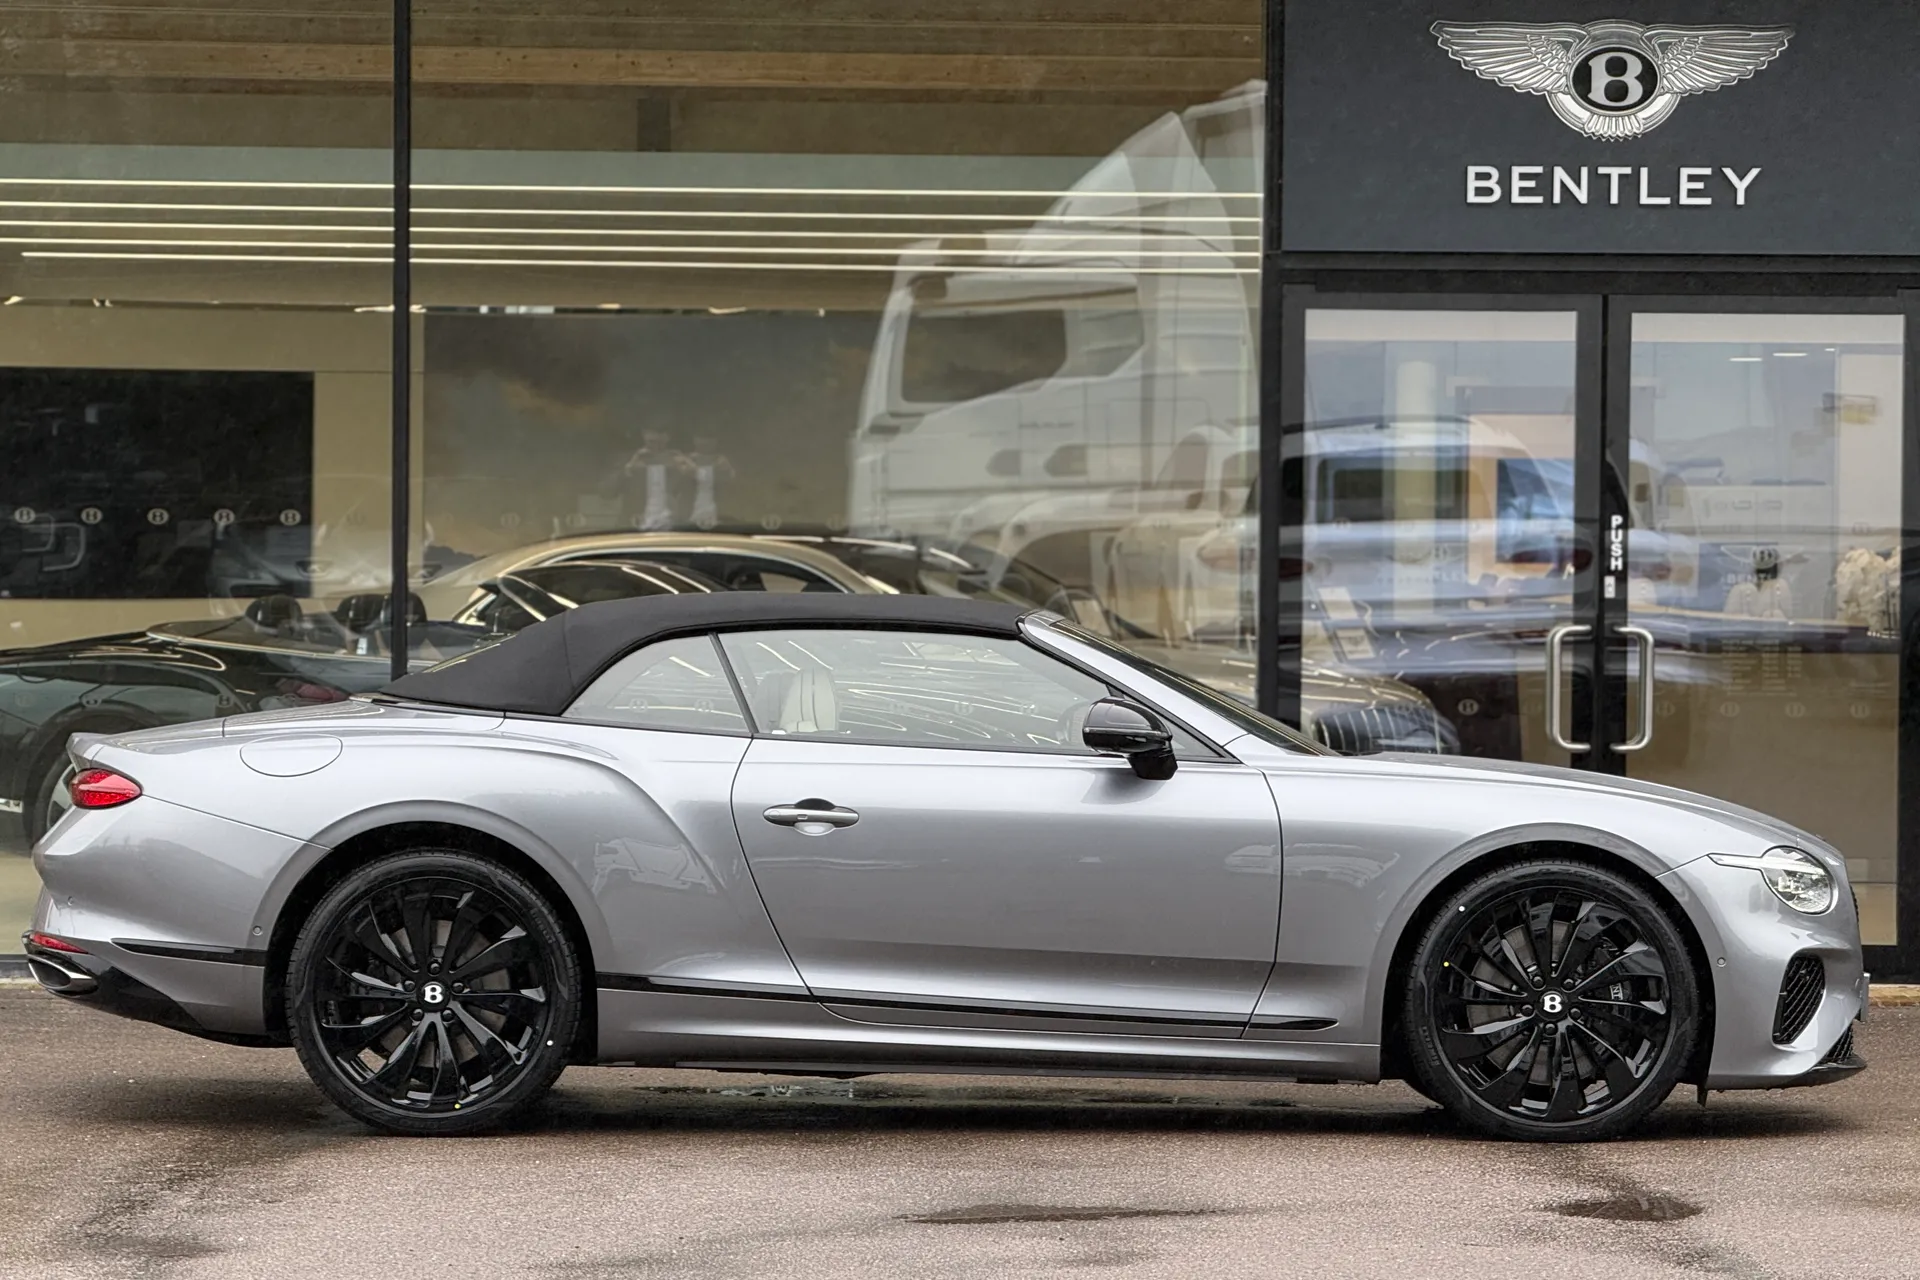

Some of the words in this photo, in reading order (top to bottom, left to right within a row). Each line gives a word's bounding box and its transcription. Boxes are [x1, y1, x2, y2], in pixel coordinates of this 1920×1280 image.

[1587, 51, 1644, 107] B
[1466, 165, 1762, 206] BENTLEY
[1610, 514, 1624, 571] PUSH
[424, 984, 444, 1004] B
[1543, 994, 1563, 1013] B
